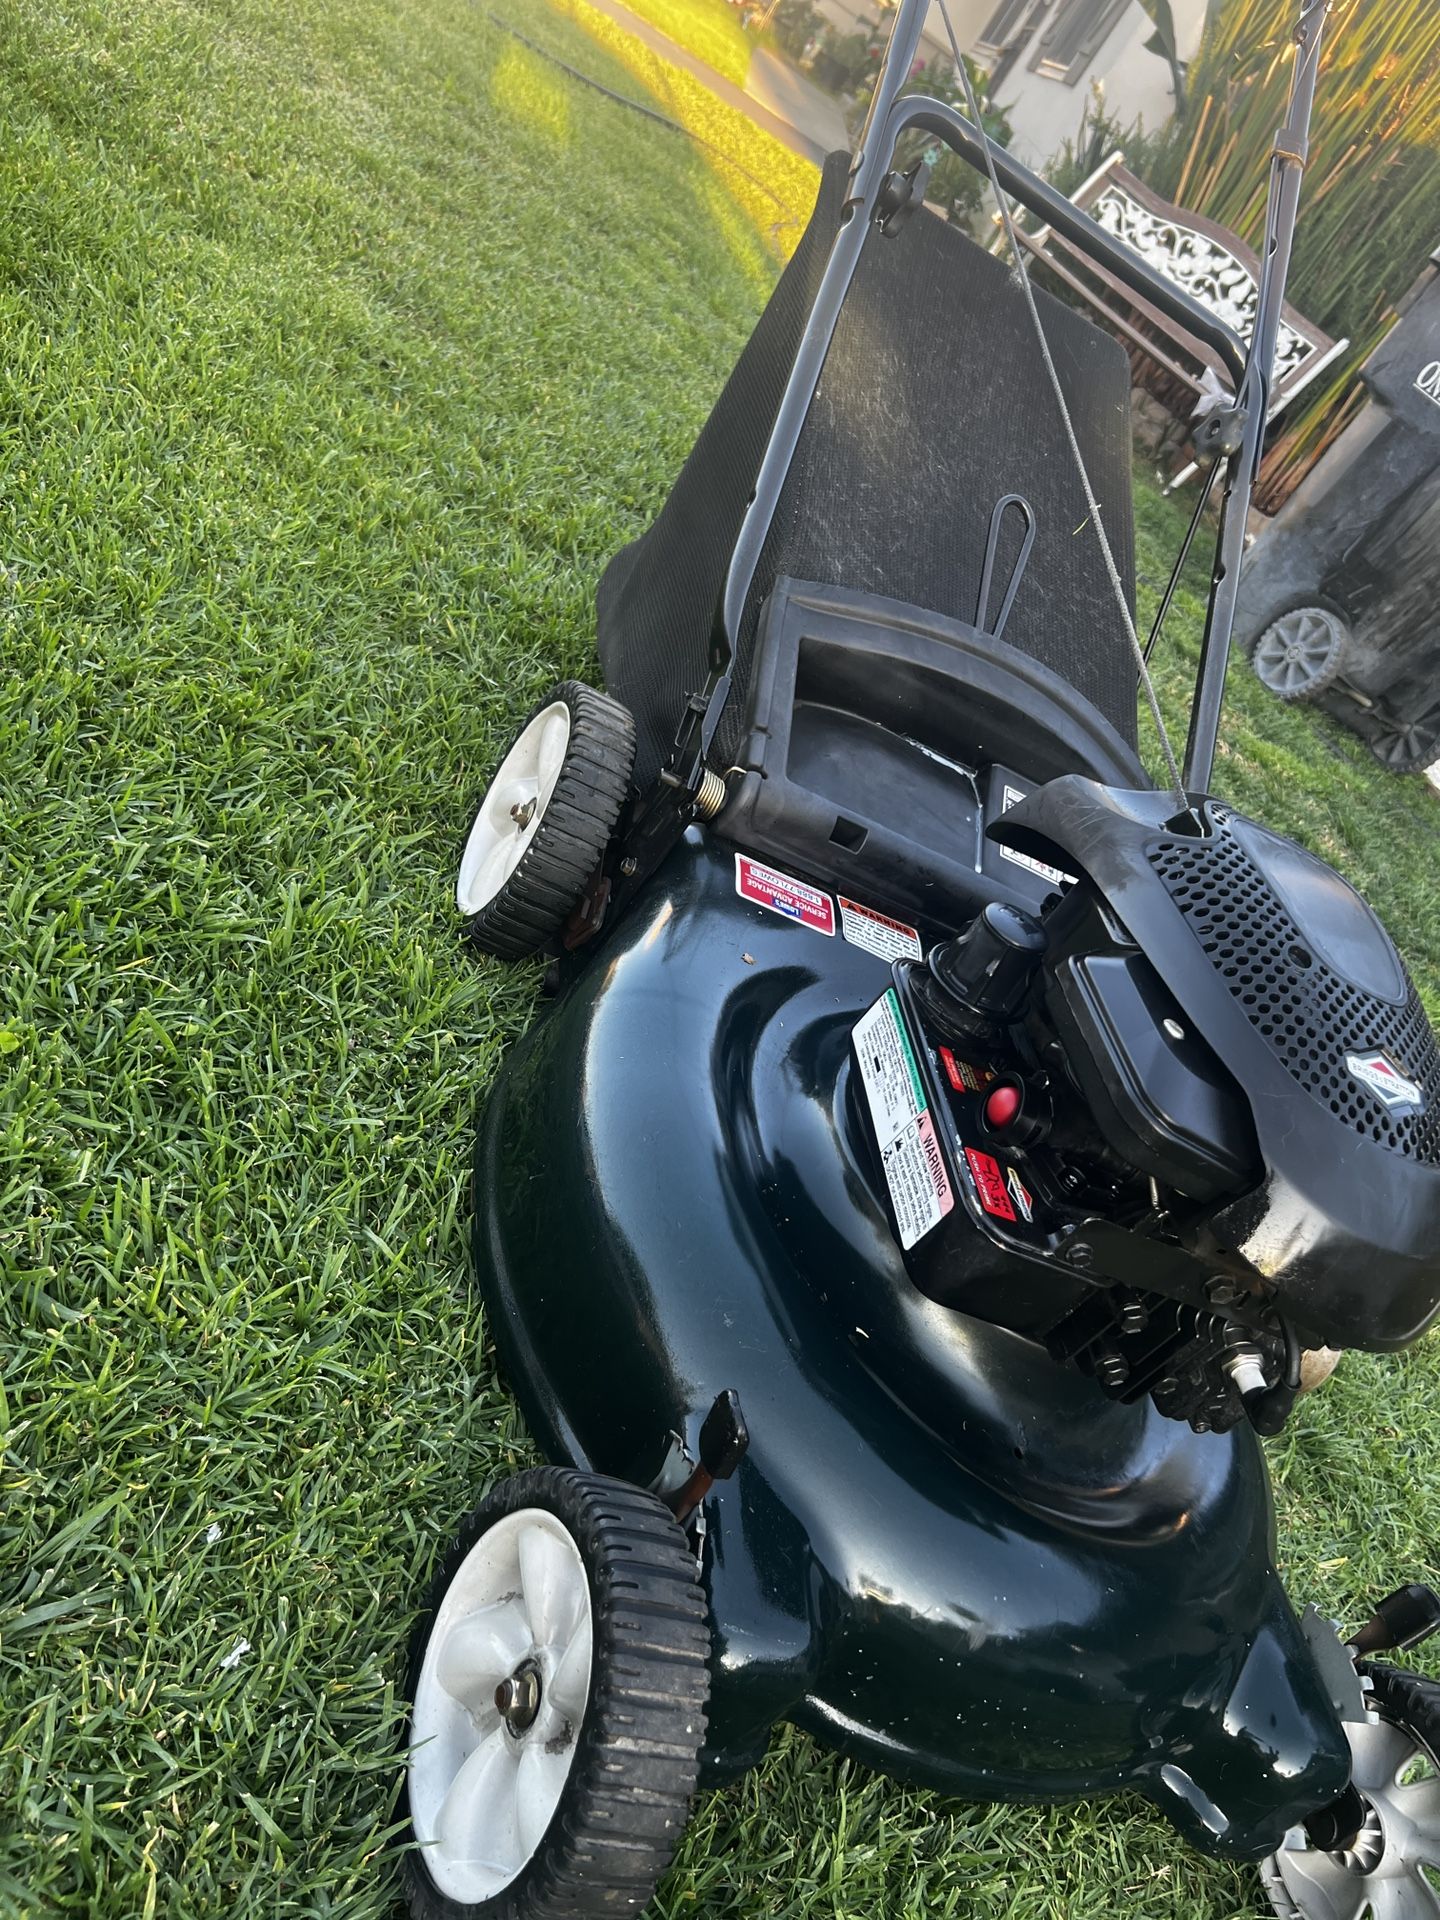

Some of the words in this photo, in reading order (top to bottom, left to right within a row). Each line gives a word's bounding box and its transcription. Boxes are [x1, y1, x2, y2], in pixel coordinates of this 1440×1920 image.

[1416, 361, 1440, 401] ON
[746, 877, 792, 905] ADVANTAGE
[774, 898, 798, 916] LOWE'S
[794, 899, 826, 920] SERVICE
[859, 907, 910, 934] WARNING
[923, 1132, 947, 1198] WARNING
[969, 1152, 981, 1171] PUSH
[976, 1173, 984, 1182] TO
[979, 1184, 992, 1206] PRIME
